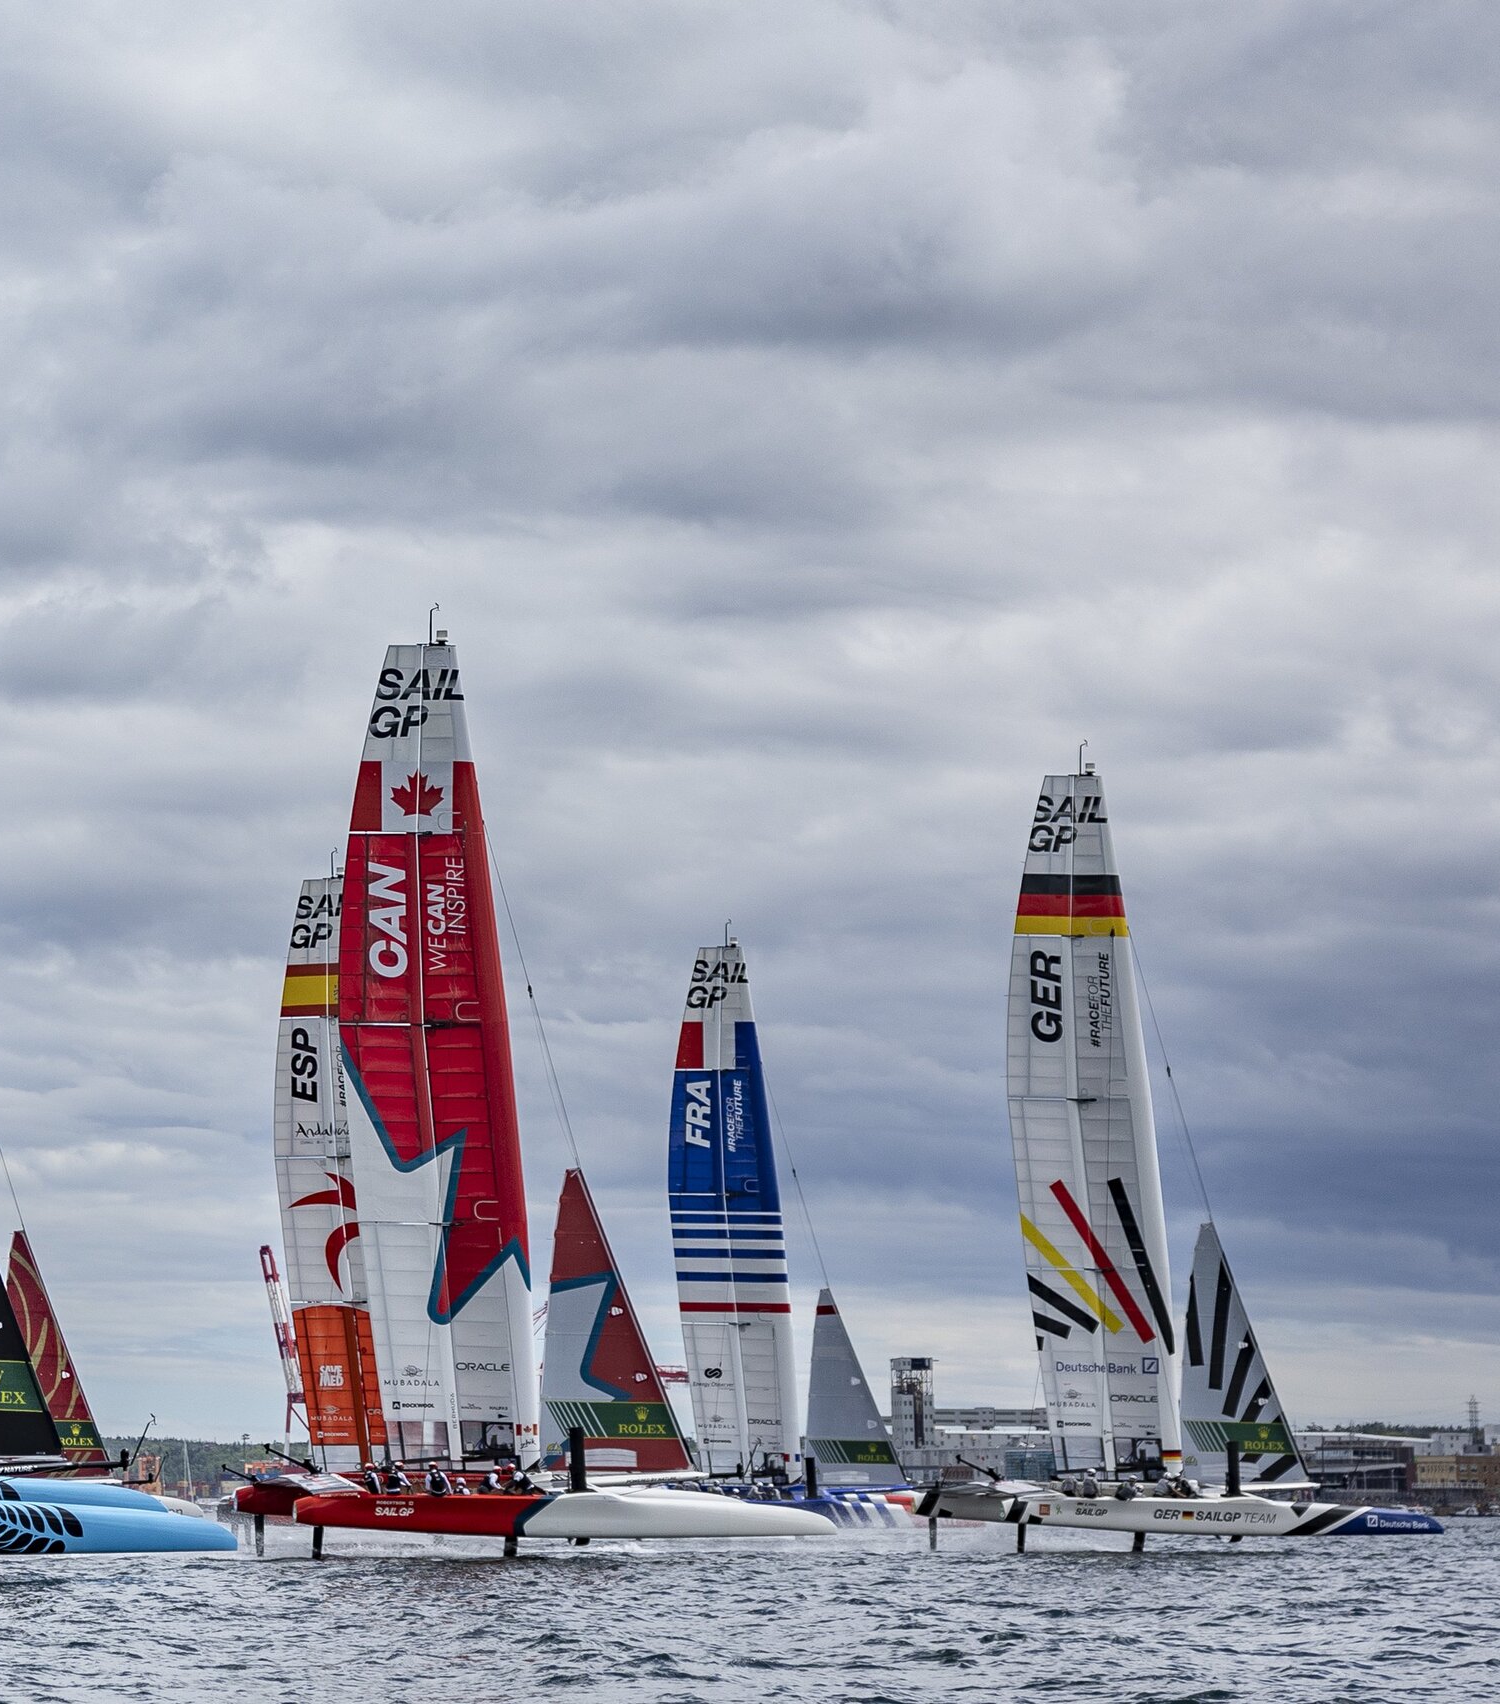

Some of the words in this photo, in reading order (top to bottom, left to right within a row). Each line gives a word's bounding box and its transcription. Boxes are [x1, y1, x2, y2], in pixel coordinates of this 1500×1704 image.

[376, 668, 465, 701] SAIL
[369, 705, 430, 738] GP
[1034, 796, 1108, 823] SAIL
[1028, 825, 1077, 853] GP
[296, 894, 342, 919] SAI
[445, 857, 466, 935] INSPIRE
[368, 862, 408, 978] CAN
[290, 923, 333, 948] GP
[691, 960, 748, 983] SAIL
[687, 986, 727, 1009] GP
[1030, 950, 1063, 1043] GER
[1100, 952, 1110, 1031] THEFUTURE
[1088, 976, 1101, 1048] #RACEFOR
[291, 1027, 318, 1103] ESP
[686, 1080, 711, 1149] FRA
[726, 1097, 736, 1153] #RACEFOR
[320, 1365, 343, 1374] SAVE
[456, 1362, 510, 1372] ORACLE
[1056, 1361, 1106, 1373] Deutsche
[1108, 1362, 1136, 1374] Bank
[320, 1374, 344, 1386] MED
[384, 1379, 440, 1387] MUBADALA
[1110, 1394, 1158, 1404] ORACLE
[618, 1423, 667, 1434] ROLEX
[747, 1418, 782, 1426] ORACLE
[1244, 1441, 1285, 1450] ROLEX
[1153, 1508, 1180, 1521] GER
[1195, 1510, 1241, 1523] SAILGP
[1244, 1512, 1277, 1524] TEAM
[1380, 1520, 1411, 1528] Deutsche
[1412, 1520, 1430, 1529] Bank
